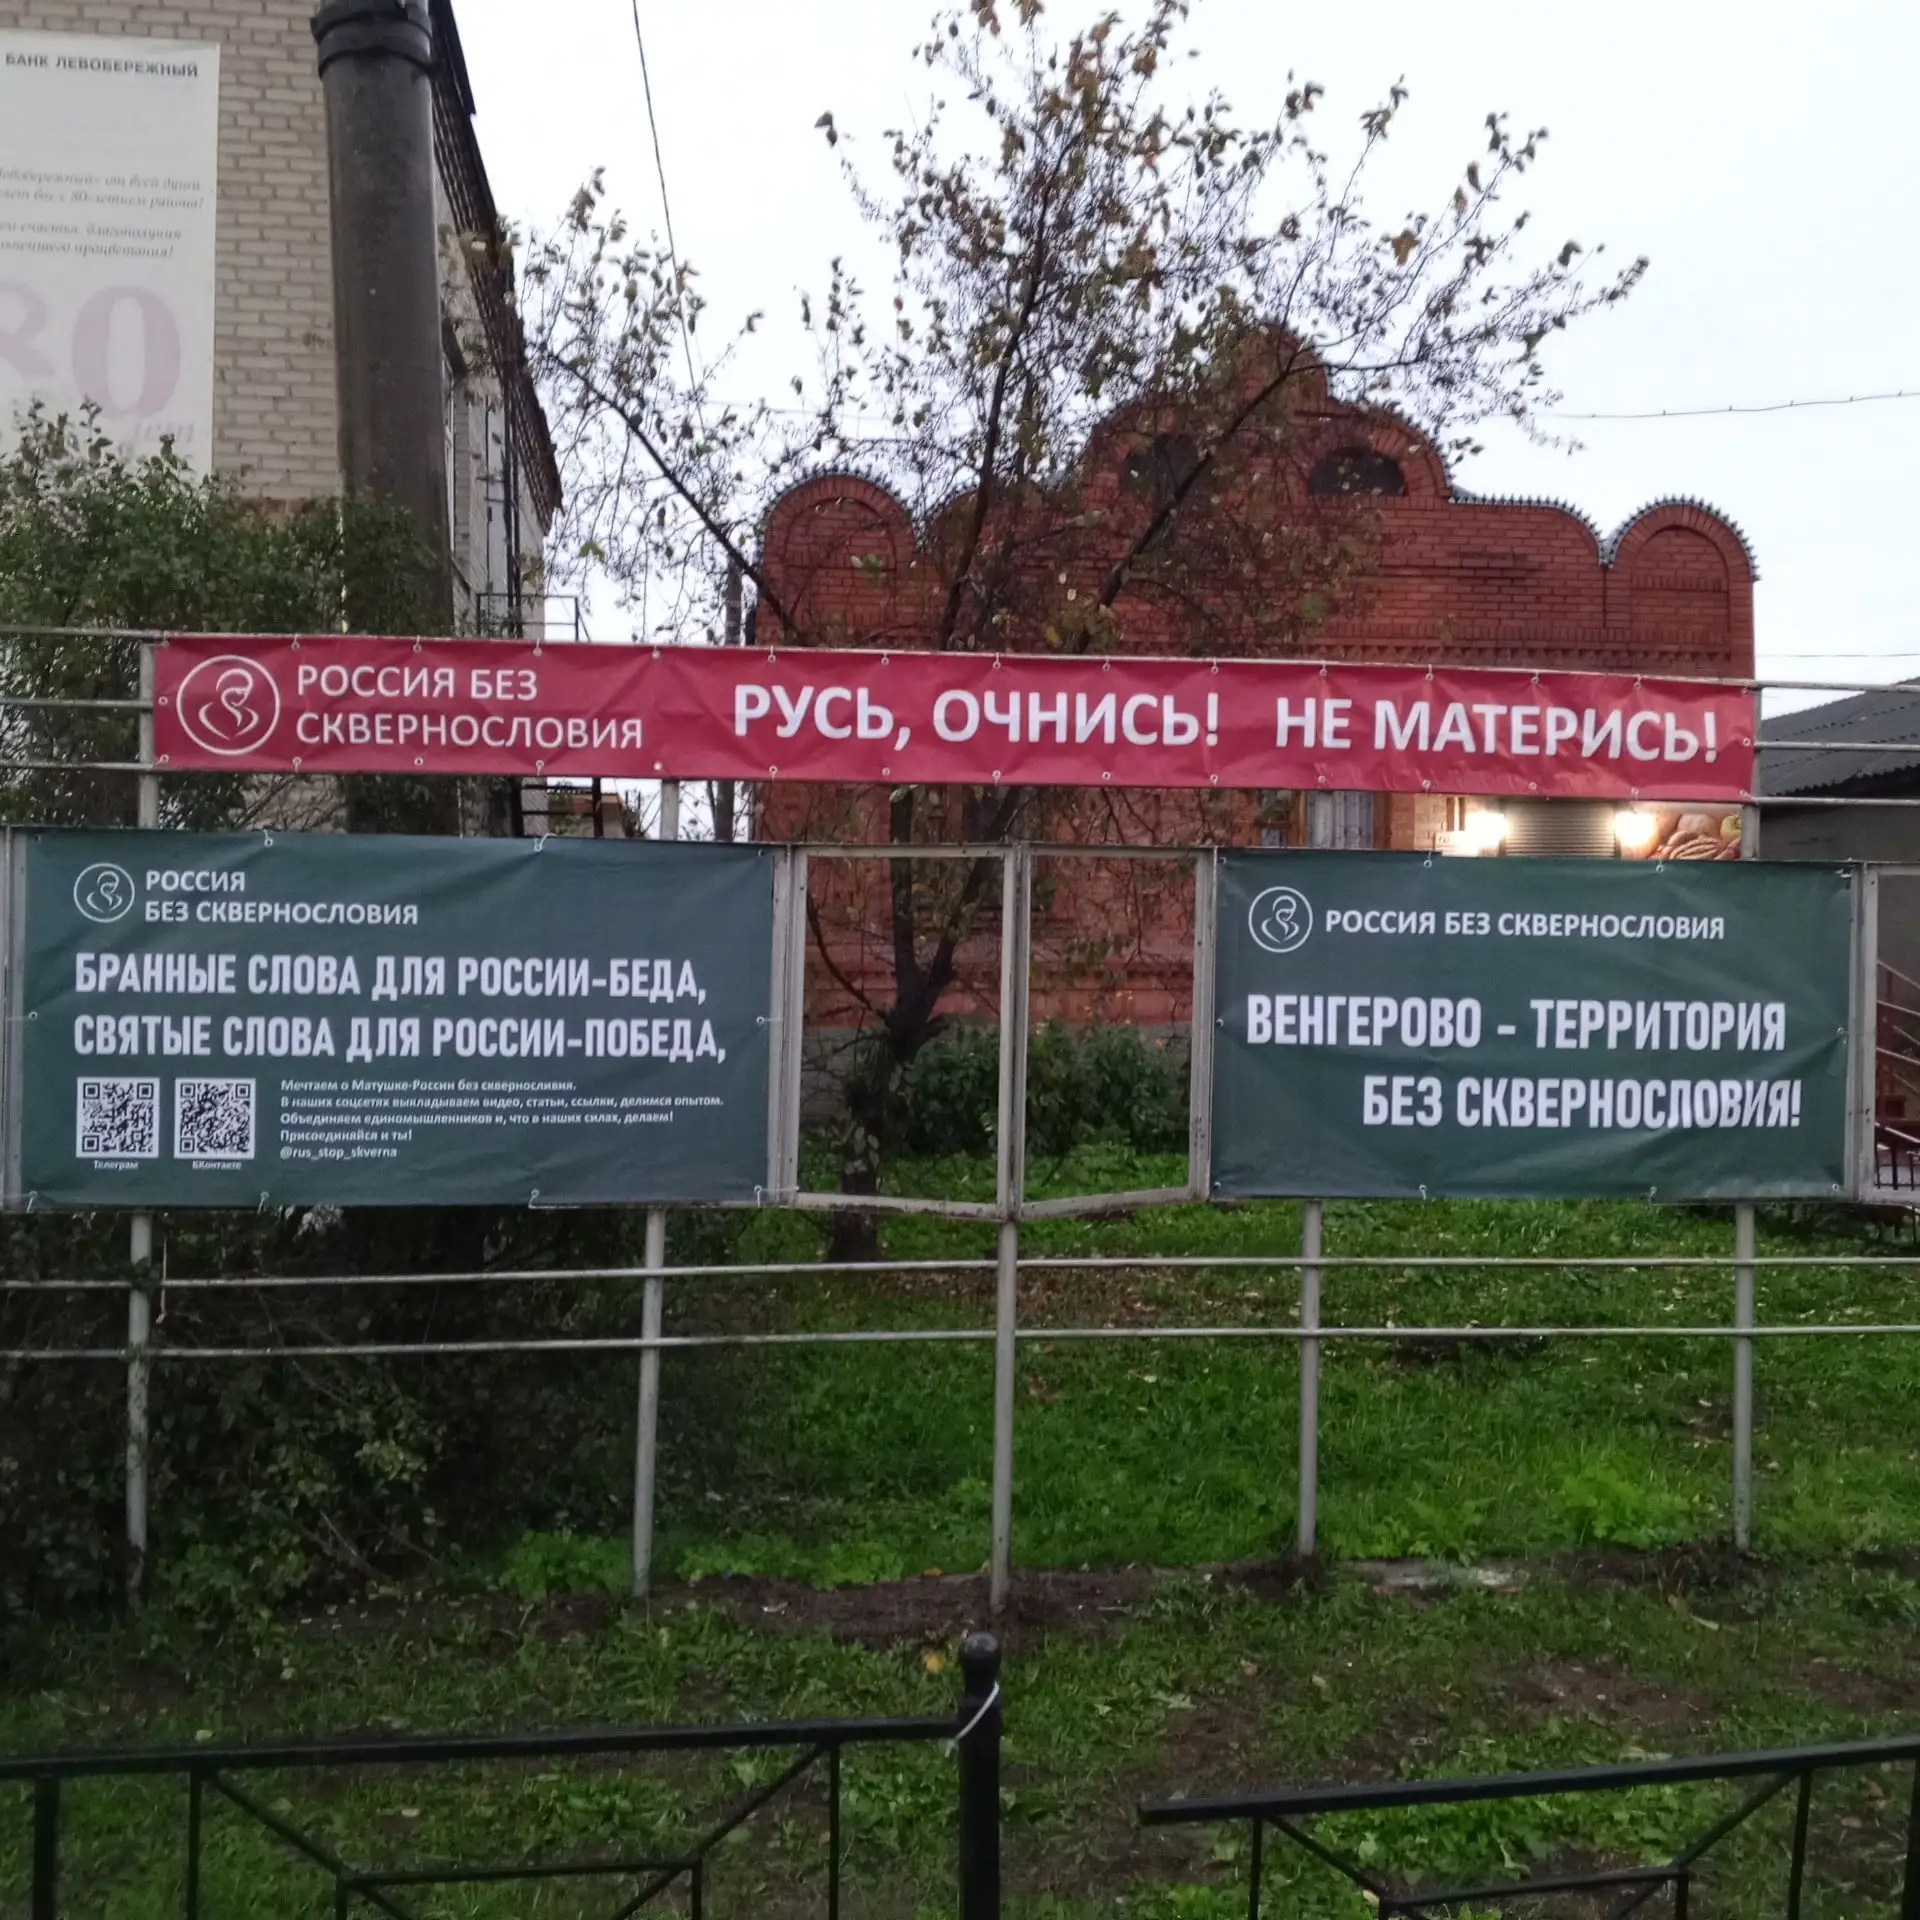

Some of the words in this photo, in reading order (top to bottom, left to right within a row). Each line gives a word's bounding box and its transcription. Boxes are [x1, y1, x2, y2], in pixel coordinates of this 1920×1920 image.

[6, 53, 49, 67] БАНК
[56, 55, 198, 77] ЛЕВОБЕРЕЖНЫЙ
[297, 664, 455, 699] РОССИЯ
[470, 669, 538, 701] БЕЗ
[296, 712, 643, 749] СКВЕРНОСЛОВИЯ
[733, 683, 911, 751] РУСЬ,
[933, 689, 1219, 747] ОЧНИСЬ!
[1276, 697, 1352, 749] НЕ
[1373, 699, 1717, 763] МАТЕРИСЬ!
[146, 869, 246, 892] РОССИЯ
[145, 900, 189, 923] БЕЗ
[196, 901, 419, 925] СКВЕРНОСЛОВИЯ
[1325, 910, 1436, 934] РОССИЯ
[1445, 912, 1490, 936] БЕЗ
[1498, 912, 1725, 940] СКВЕРНОСЛОВИЯ
[75, 952, 237, 994] БРАННЫЕ
[248, 954, 361, 995] СЛОВА
[371, 956, 446, 1002] ДЛЯ
[458, 957, 706, 1005] РОССИИ-БЕДА,
[1246, 994, 1482, 1048] ВЕНГЕРОВО
[1530, 999, 1786, 1051] ТЕРРИТОРИЯ
[74, 1014, 212, 1056] СВЯТЫЕ
[223, 1016, 335, 1057] СЛОВА
[346, 1017, 421, 1063] ДЛЯ
[433, 1018, 726, 1064] РОССИИ-ПОБЕДА,
[281, 1079, 338, 1091] Мечтаем
[458, 1079, 479, 1091] без
[281, 1096, 289, 1107] В
[292, 1098, 332, 1108] наших
[335, 1098, 389, 1109] соцсетях
[392, 1098, 480, 1109] выкладываем
[483, 1098, 523, 1109] видео,
[526, 1098, 568, 1108] статьи,
[571, 1097, 618, 1108] ссылки,
[620, 1097, 672, 1108] делимся
[675, 1096, 724, 1107] опытом.
[1363, 1075, 1442, 1126] БЕЗ
[1457, 1077, 1801, 1129] СКВЕРНОСЛОВИЯ!
[280, 1112, 361, 1126] Объединяем
[364, 1114, 493, 1126] единомышленников
[495, 1115, 507, 1126] и,
[509, 1115, 530, 1124] что
[542, 1114, 582, 1124] наших
[584, 1114, 622, 1125] силах,
[624, 1110, 673, 1124] делаем!
[281, 1129, 378, 1143] Присоединяйся
[392, 1129, 412, 1141] ты!
